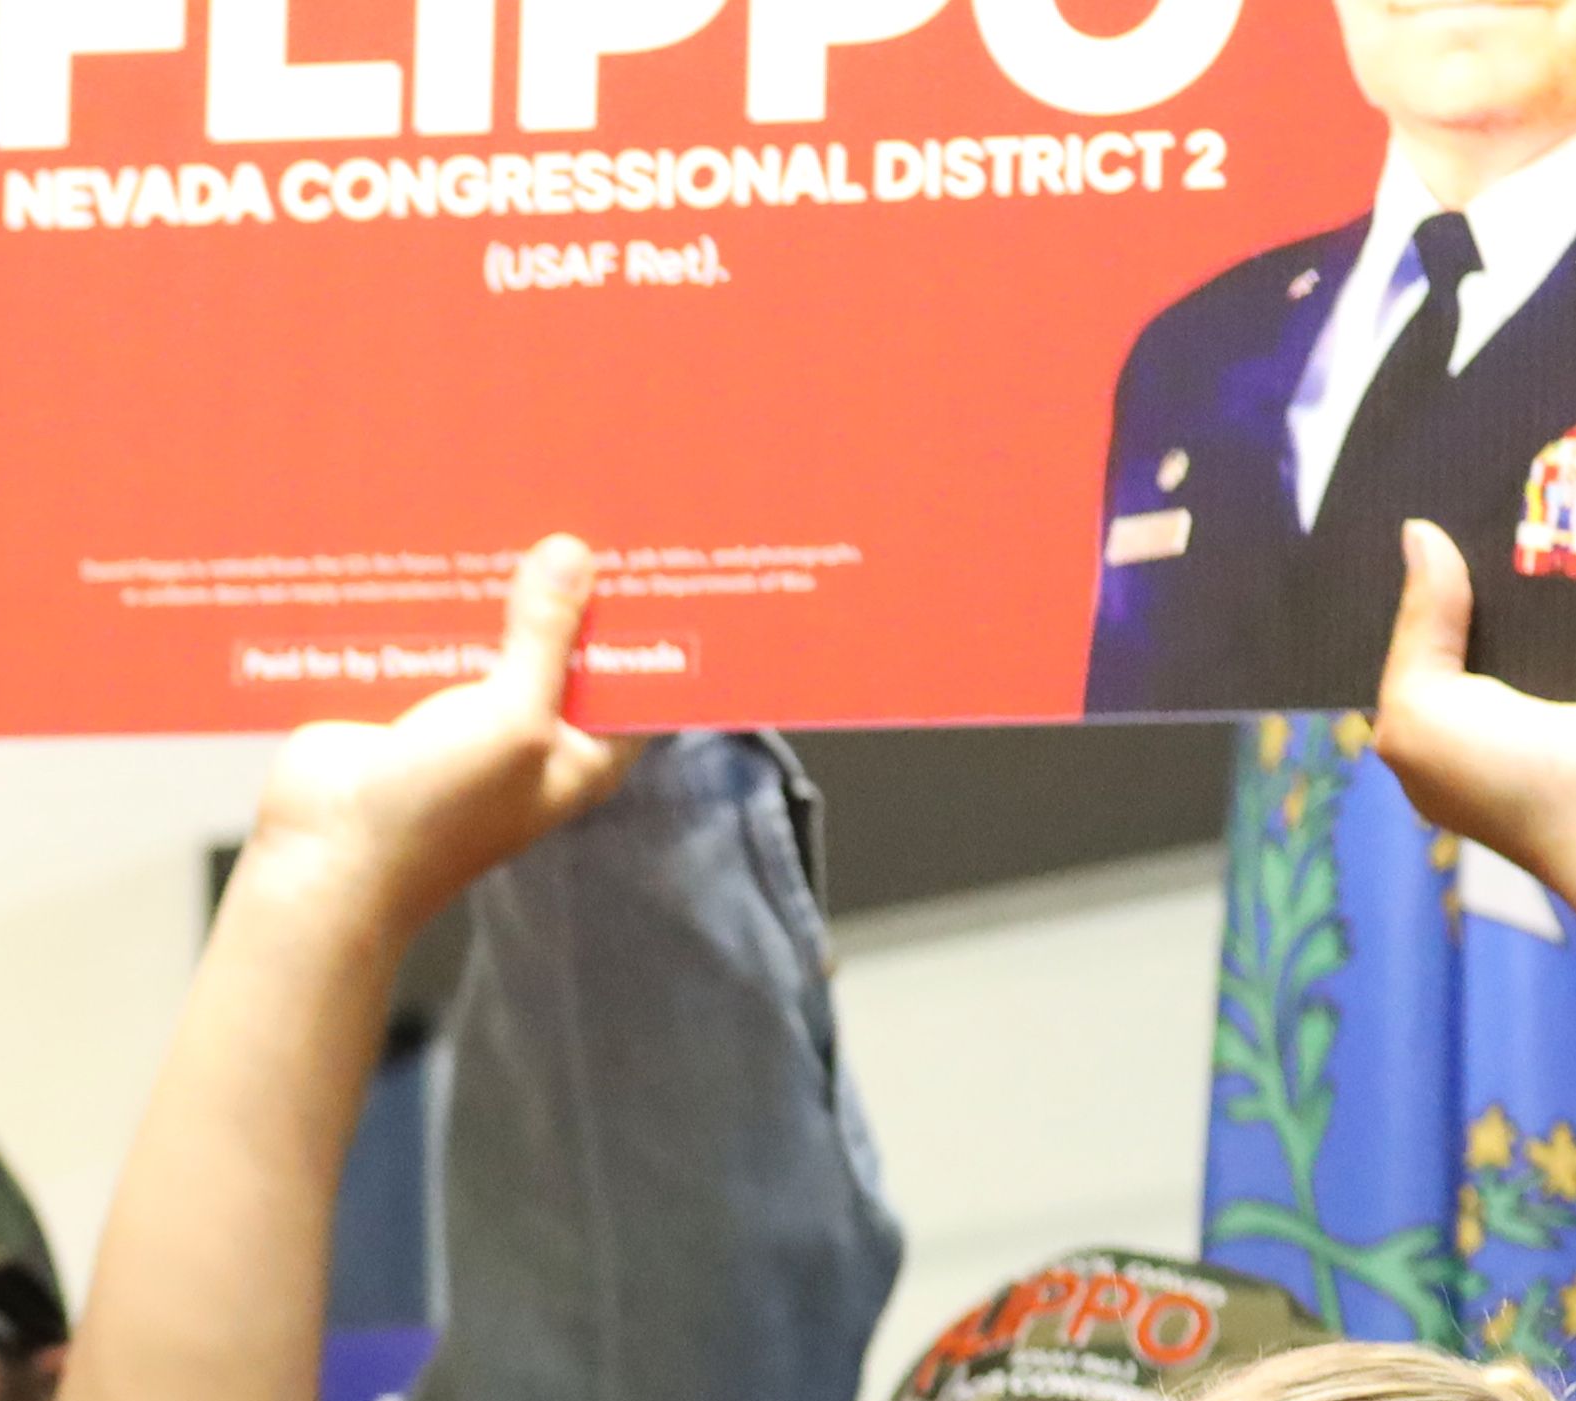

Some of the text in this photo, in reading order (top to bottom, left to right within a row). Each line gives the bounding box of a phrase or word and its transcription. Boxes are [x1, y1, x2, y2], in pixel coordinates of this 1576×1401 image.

[4, 128, 1228, 232] NEVADA CONGRESSIONAL DISTRICT 2
